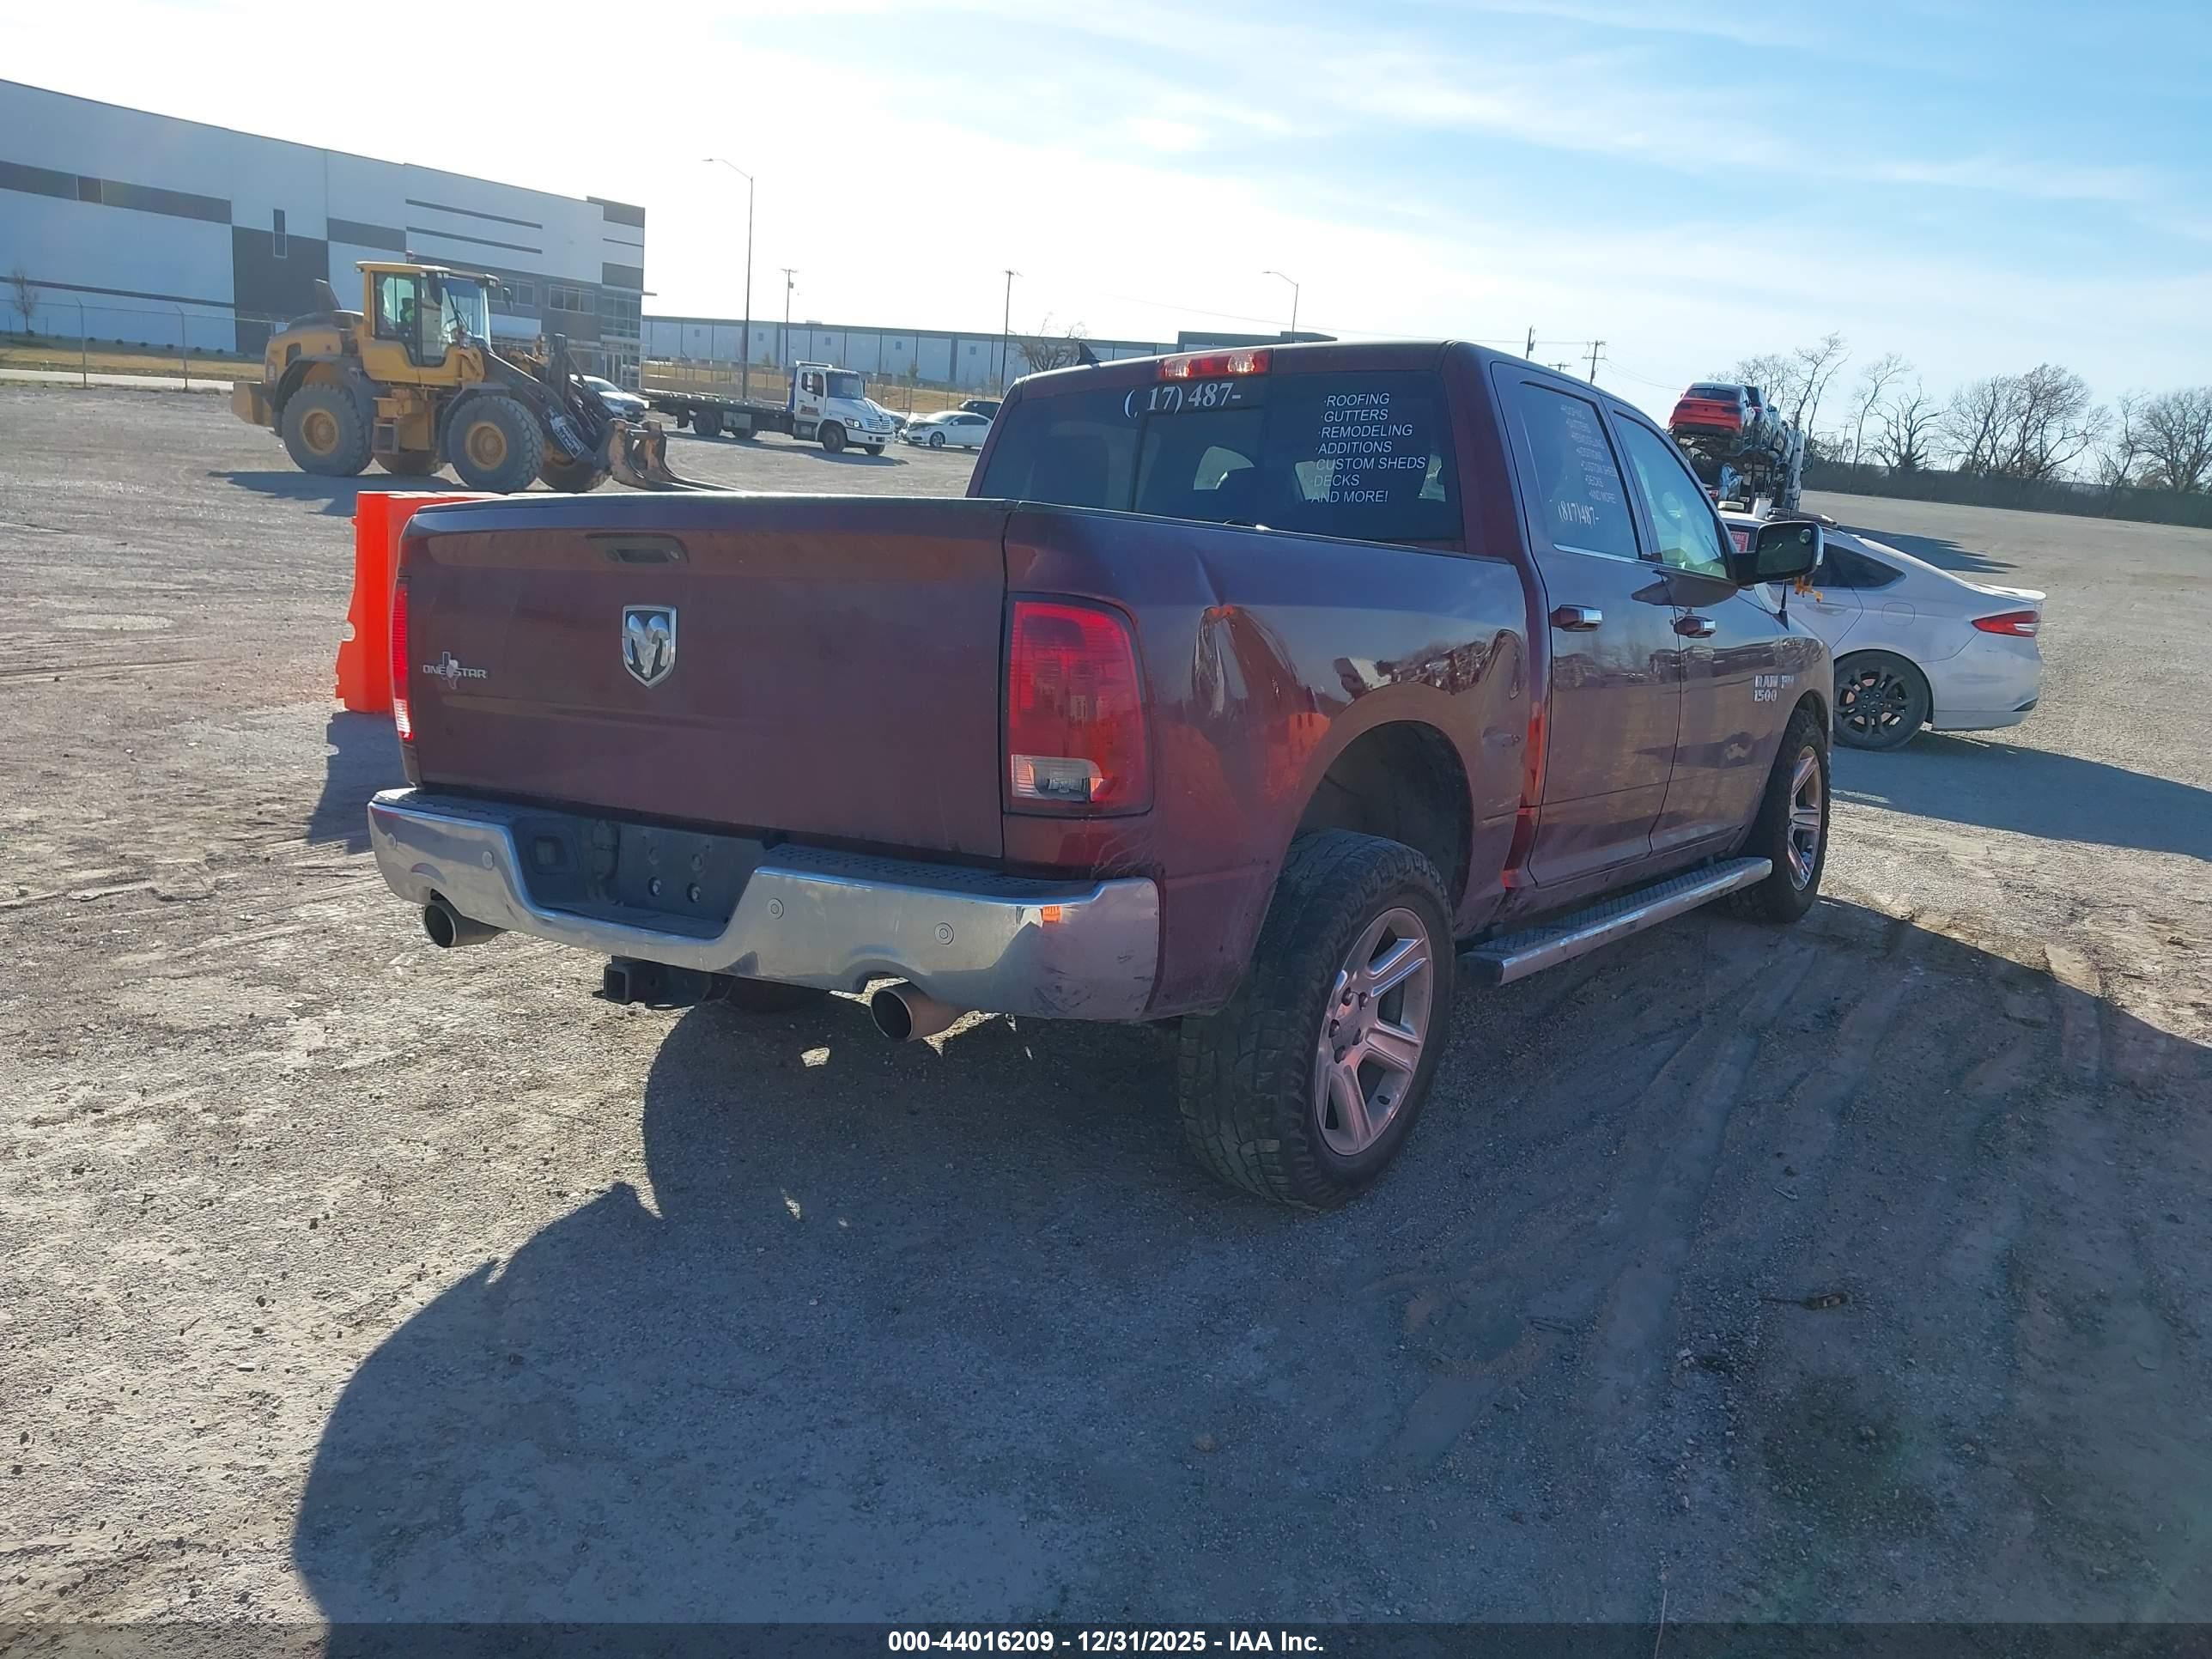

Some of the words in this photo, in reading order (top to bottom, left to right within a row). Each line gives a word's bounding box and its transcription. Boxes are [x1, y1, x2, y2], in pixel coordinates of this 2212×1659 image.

[1124, 386, 1183, 418] (17)
[1326, 392, 1390, 407] ROOFING
[1323, 409, 1389, 422] GUTTERS
[1321, 424, 1413, 439] REMODELING
[1318, 441, 1393, 454] ADDITIONS
[1316, 457, 1376, 471] CUSTOM
[1377, 456, 1426, 470] SHEDS
[1314, 474, 1360, 487] DECKS
[1310, 491, 1340, 503] AND
[1343, 490, 1389, 503] MORE!
[1754, 689, 1778, 702] 1500
